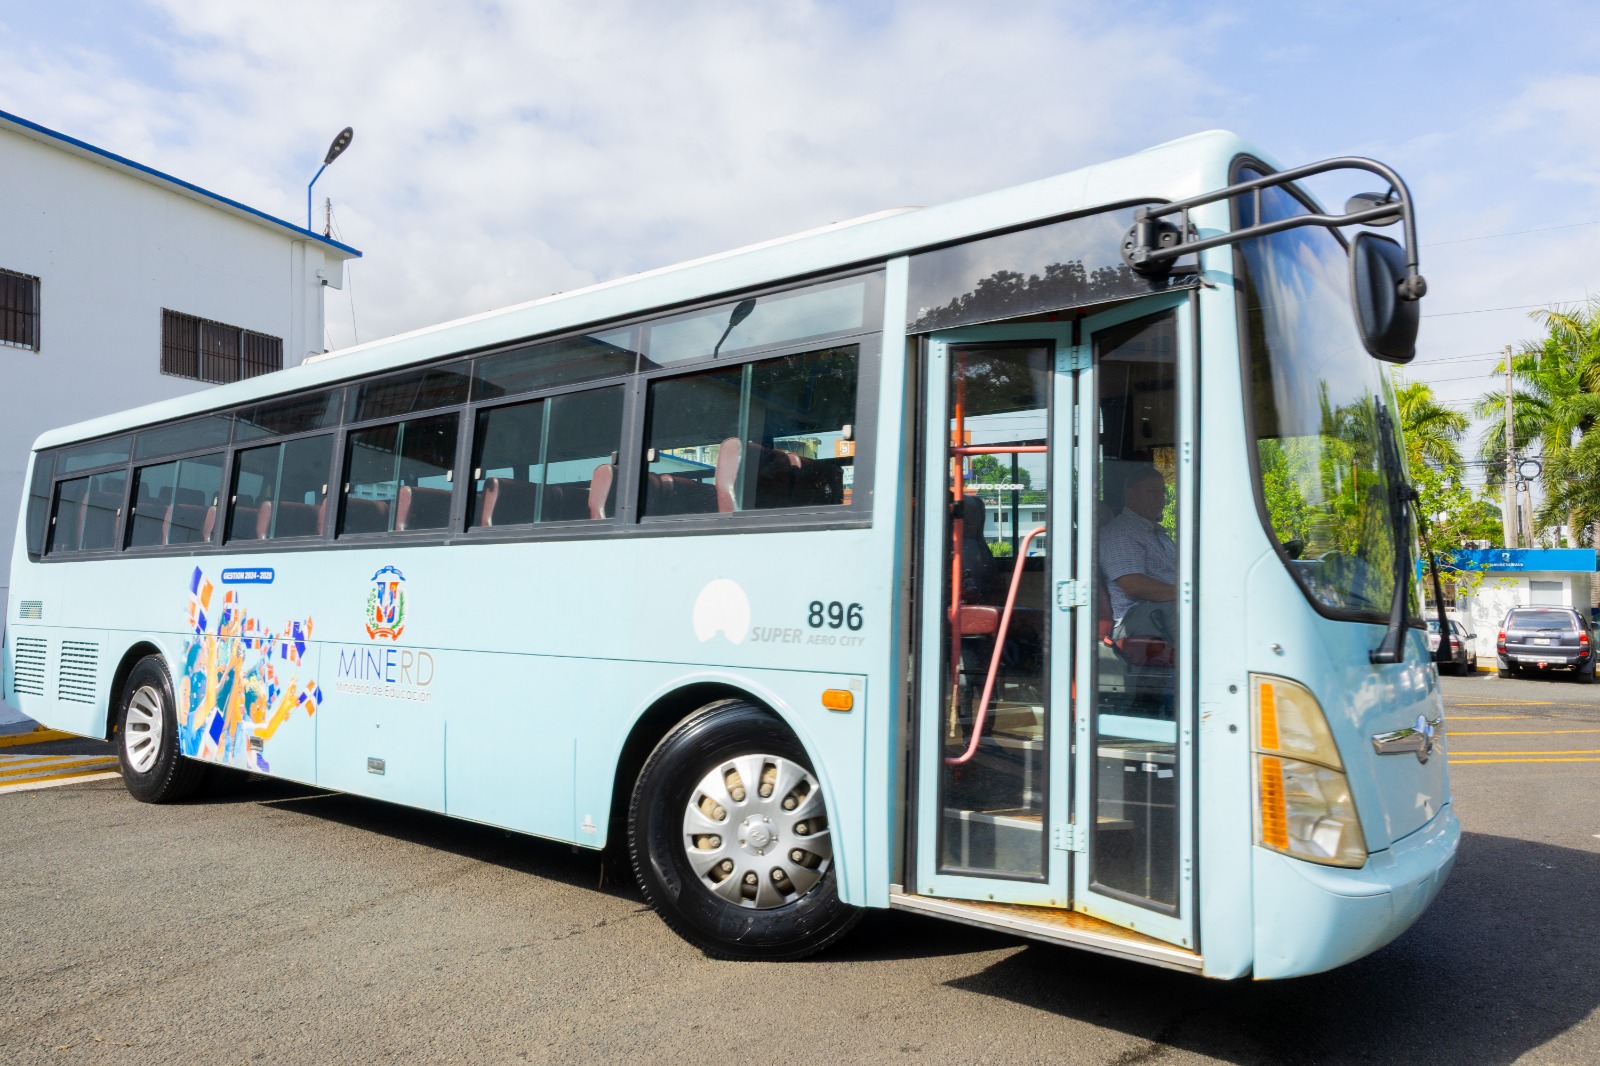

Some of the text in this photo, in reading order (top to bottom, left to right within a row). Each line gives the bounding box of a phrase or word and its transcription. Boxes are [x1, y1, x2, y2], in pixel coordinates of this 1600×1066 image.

[808, 600, 864, 631] 896
[750, 627, 866, 647] SUPER AERO CITY
[337, 647, 434, 687] MINERD
[371, 684, 383, 697] de
